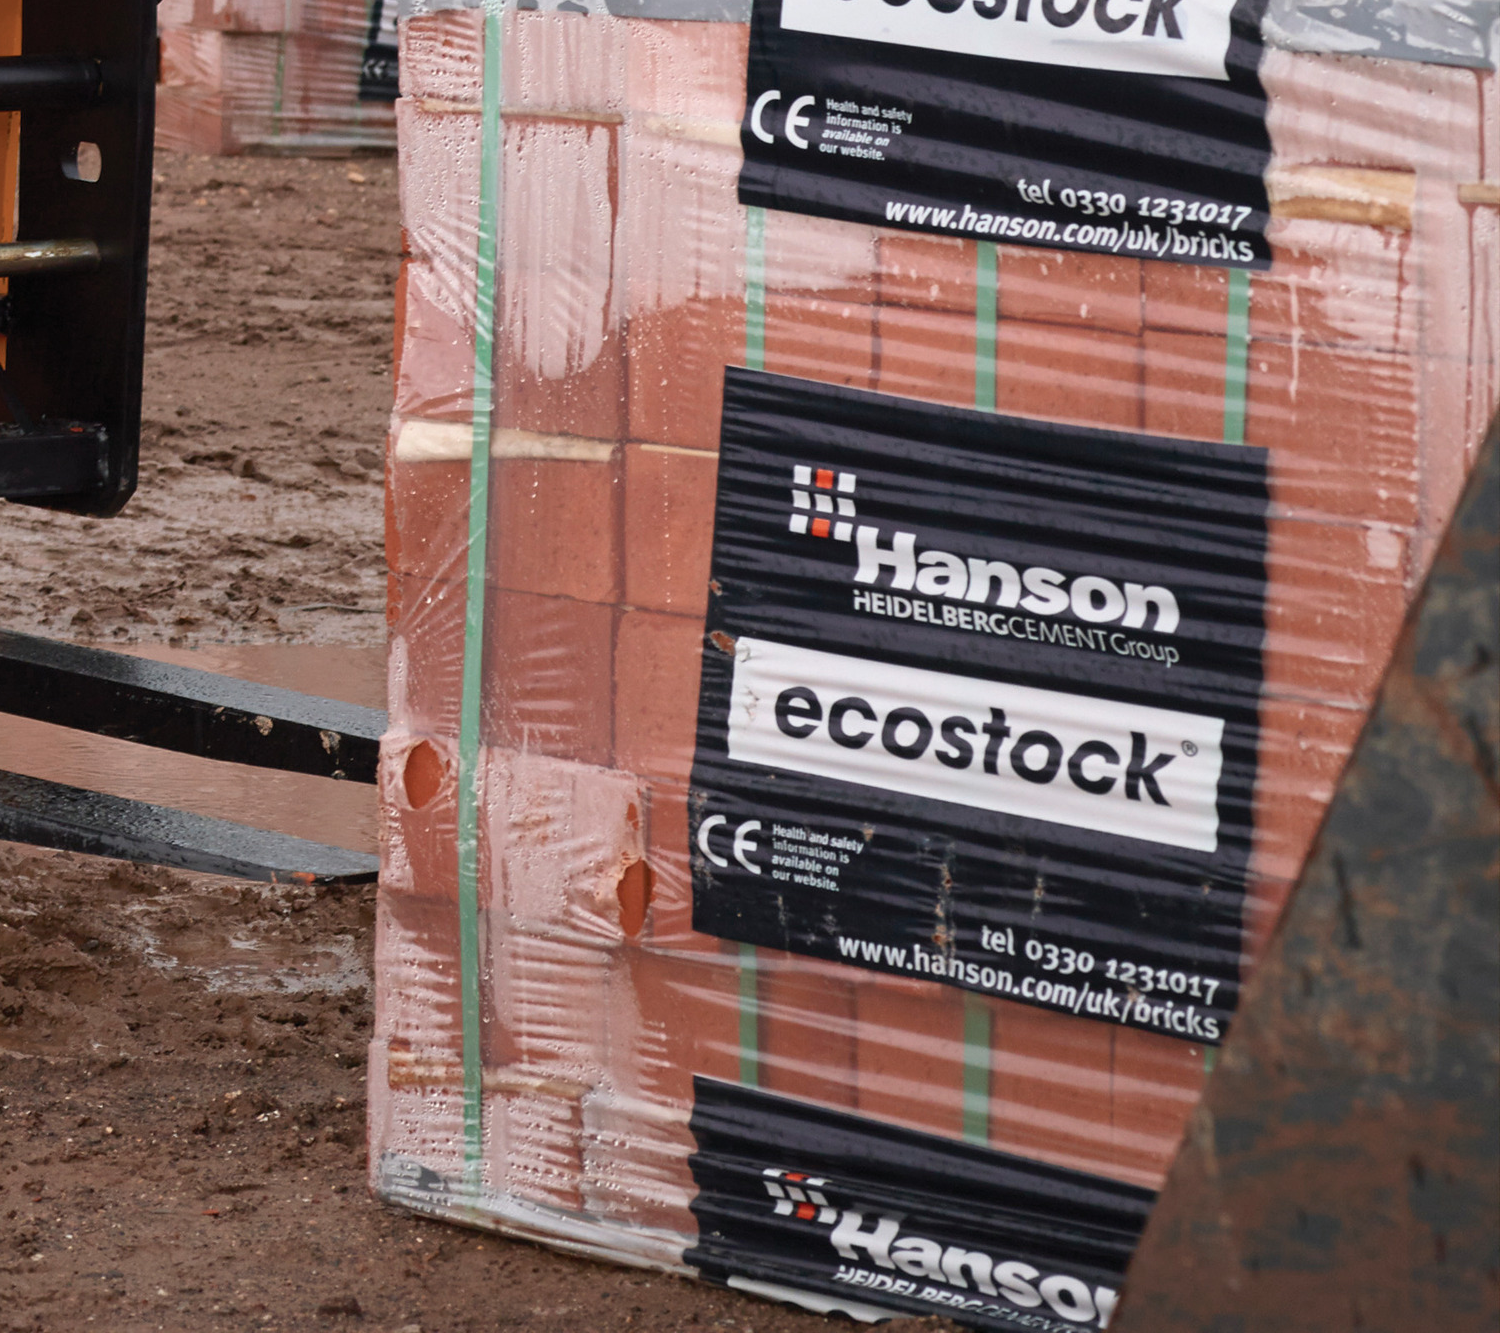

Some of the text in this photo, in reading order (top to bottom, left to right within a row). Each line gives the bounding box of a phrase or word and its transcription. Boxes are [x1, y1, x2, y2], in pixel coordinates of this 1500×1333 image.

[825, 98, 913, 124] Health and safety
[826, 112, 902, 135] information is
[821, 128, 890, 147] available on
[819, 142, 886, 161] our website.
[1017, 179, 1252, 231] tel 0330 1231017
[885, 200, 1255, 263] www.hanson.com/uk/bricks
[853, 526, 1181, 634] Hanson
[772, 823, 864, 854] Health and safety
[772, 838, 850, 864] information is
[771, 853, 840, 877] available on
[771, 870, 840, 892] our website.
[981, 923, 1220, 1007] tel 0330 1231017
[838, 933, 1220, 1041] www.hanson.com/uk/bricks
